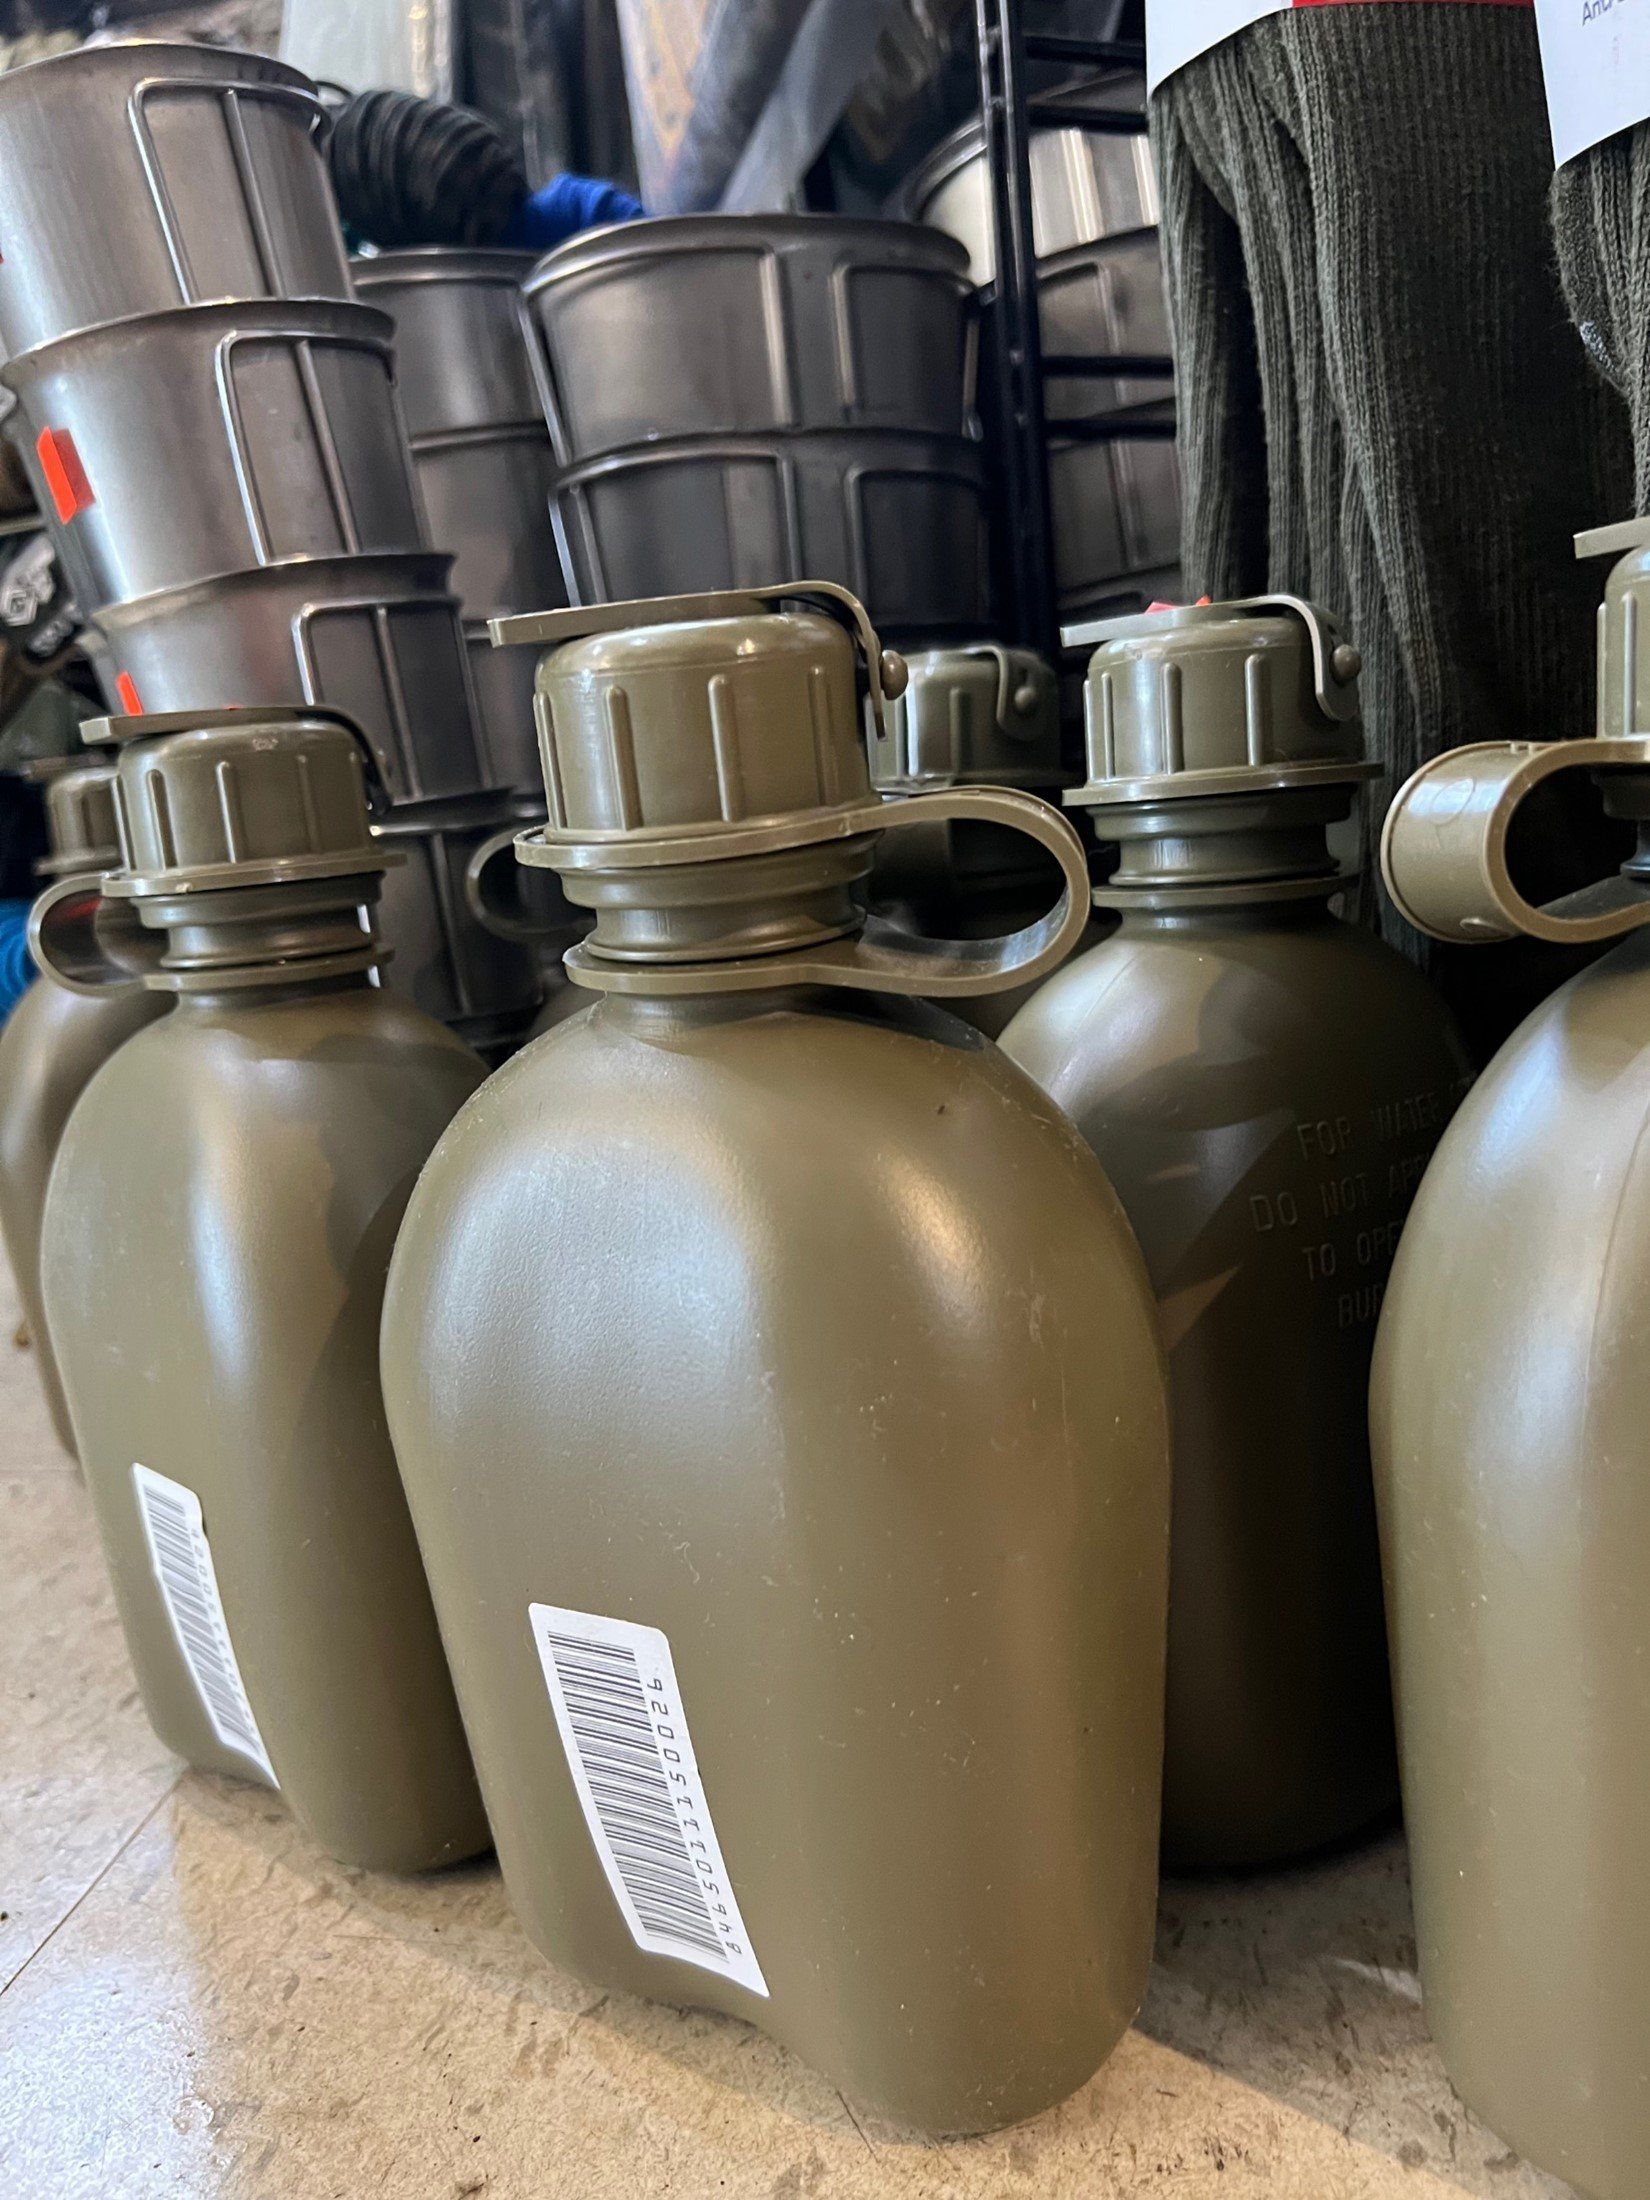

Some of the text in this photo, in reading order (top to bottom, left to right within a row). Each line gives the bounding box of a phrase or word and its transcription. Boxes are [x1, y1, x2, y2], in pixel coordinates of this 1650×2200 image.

[1296, 1115, 1352, 1161] FOR
[1249, 1191, 1298, 1232] DO
[1319, 1172, 1369, 1218] NOT
[1301, 1242, 1337, 1281] TO
[647, 1679, 742, 1954] 8465011150026
